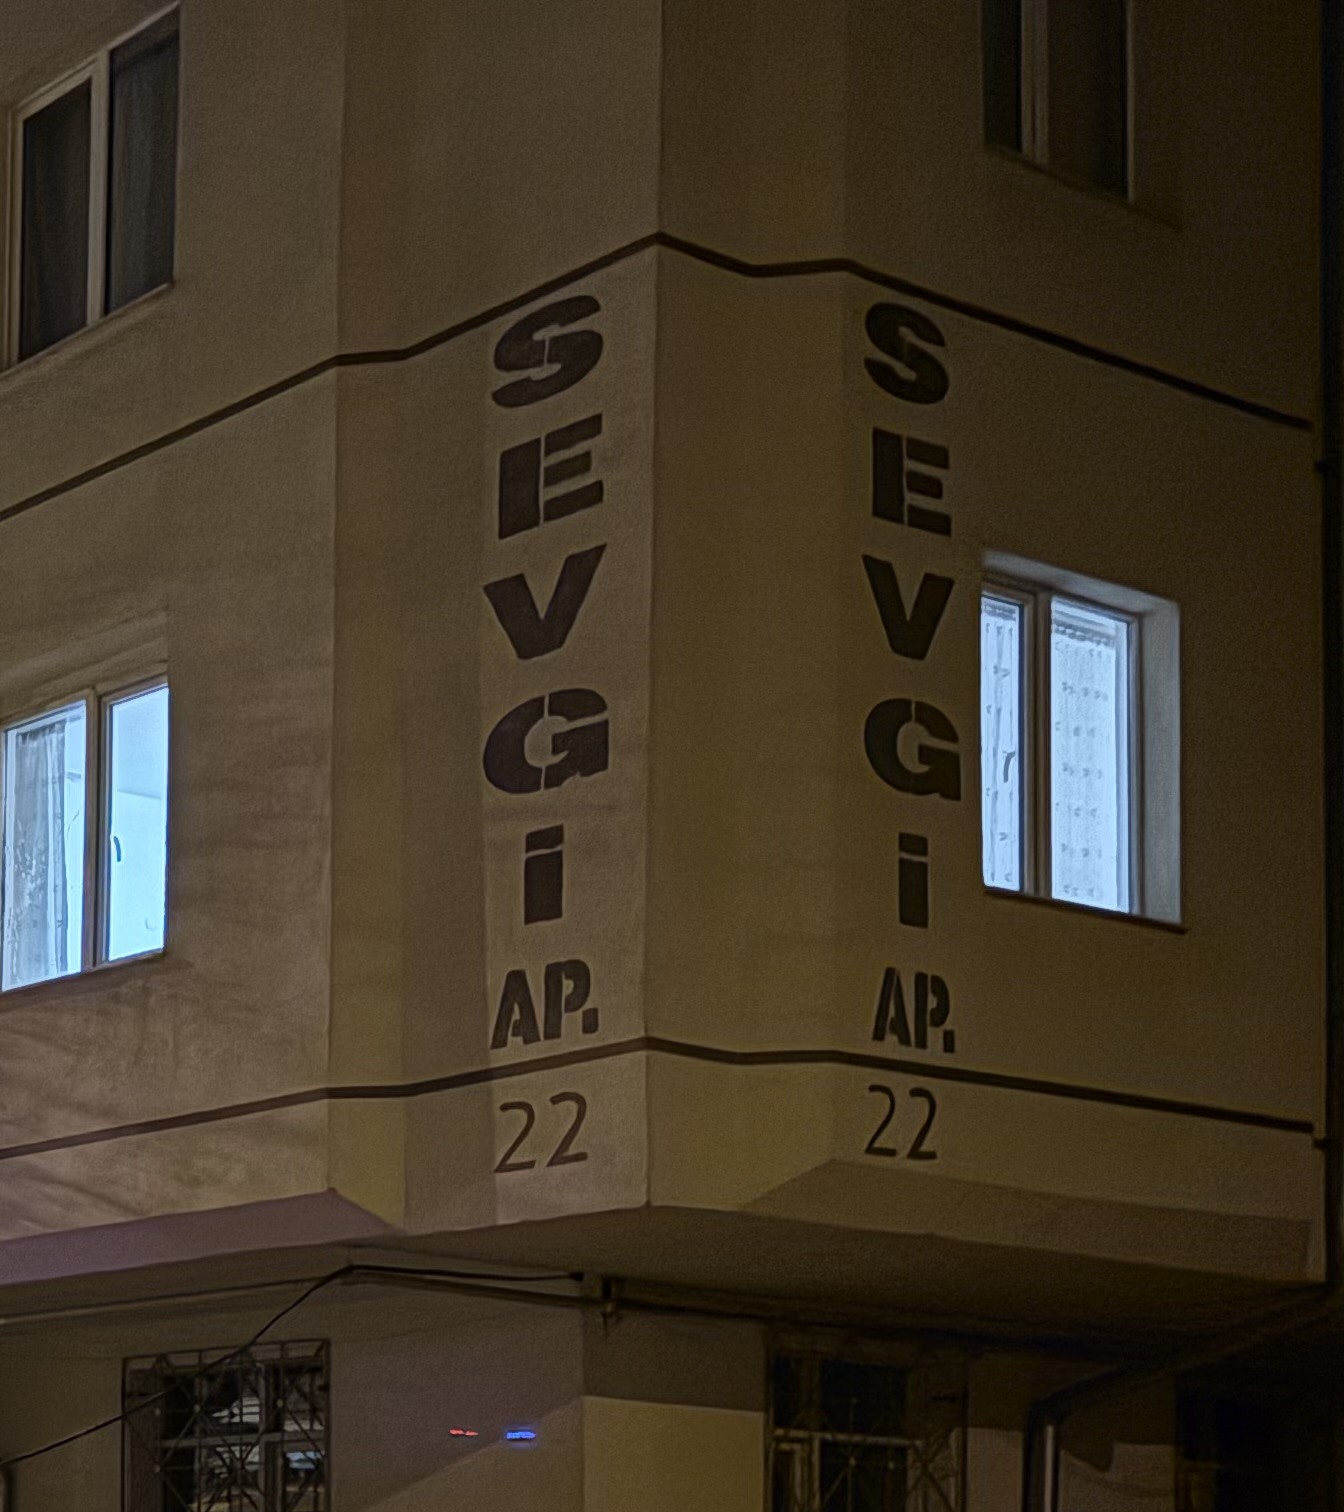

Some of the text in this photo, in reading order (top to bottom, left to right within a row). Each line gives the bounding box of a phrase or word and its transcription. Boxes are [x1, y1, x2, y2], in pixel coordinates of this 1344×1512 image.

[490, 959, 599, 1050] AP.
[871, 966, 955, 1053] AP.
[493, 1091, 589, 1173] 22
[864, 1085, 937, 1160] 22
